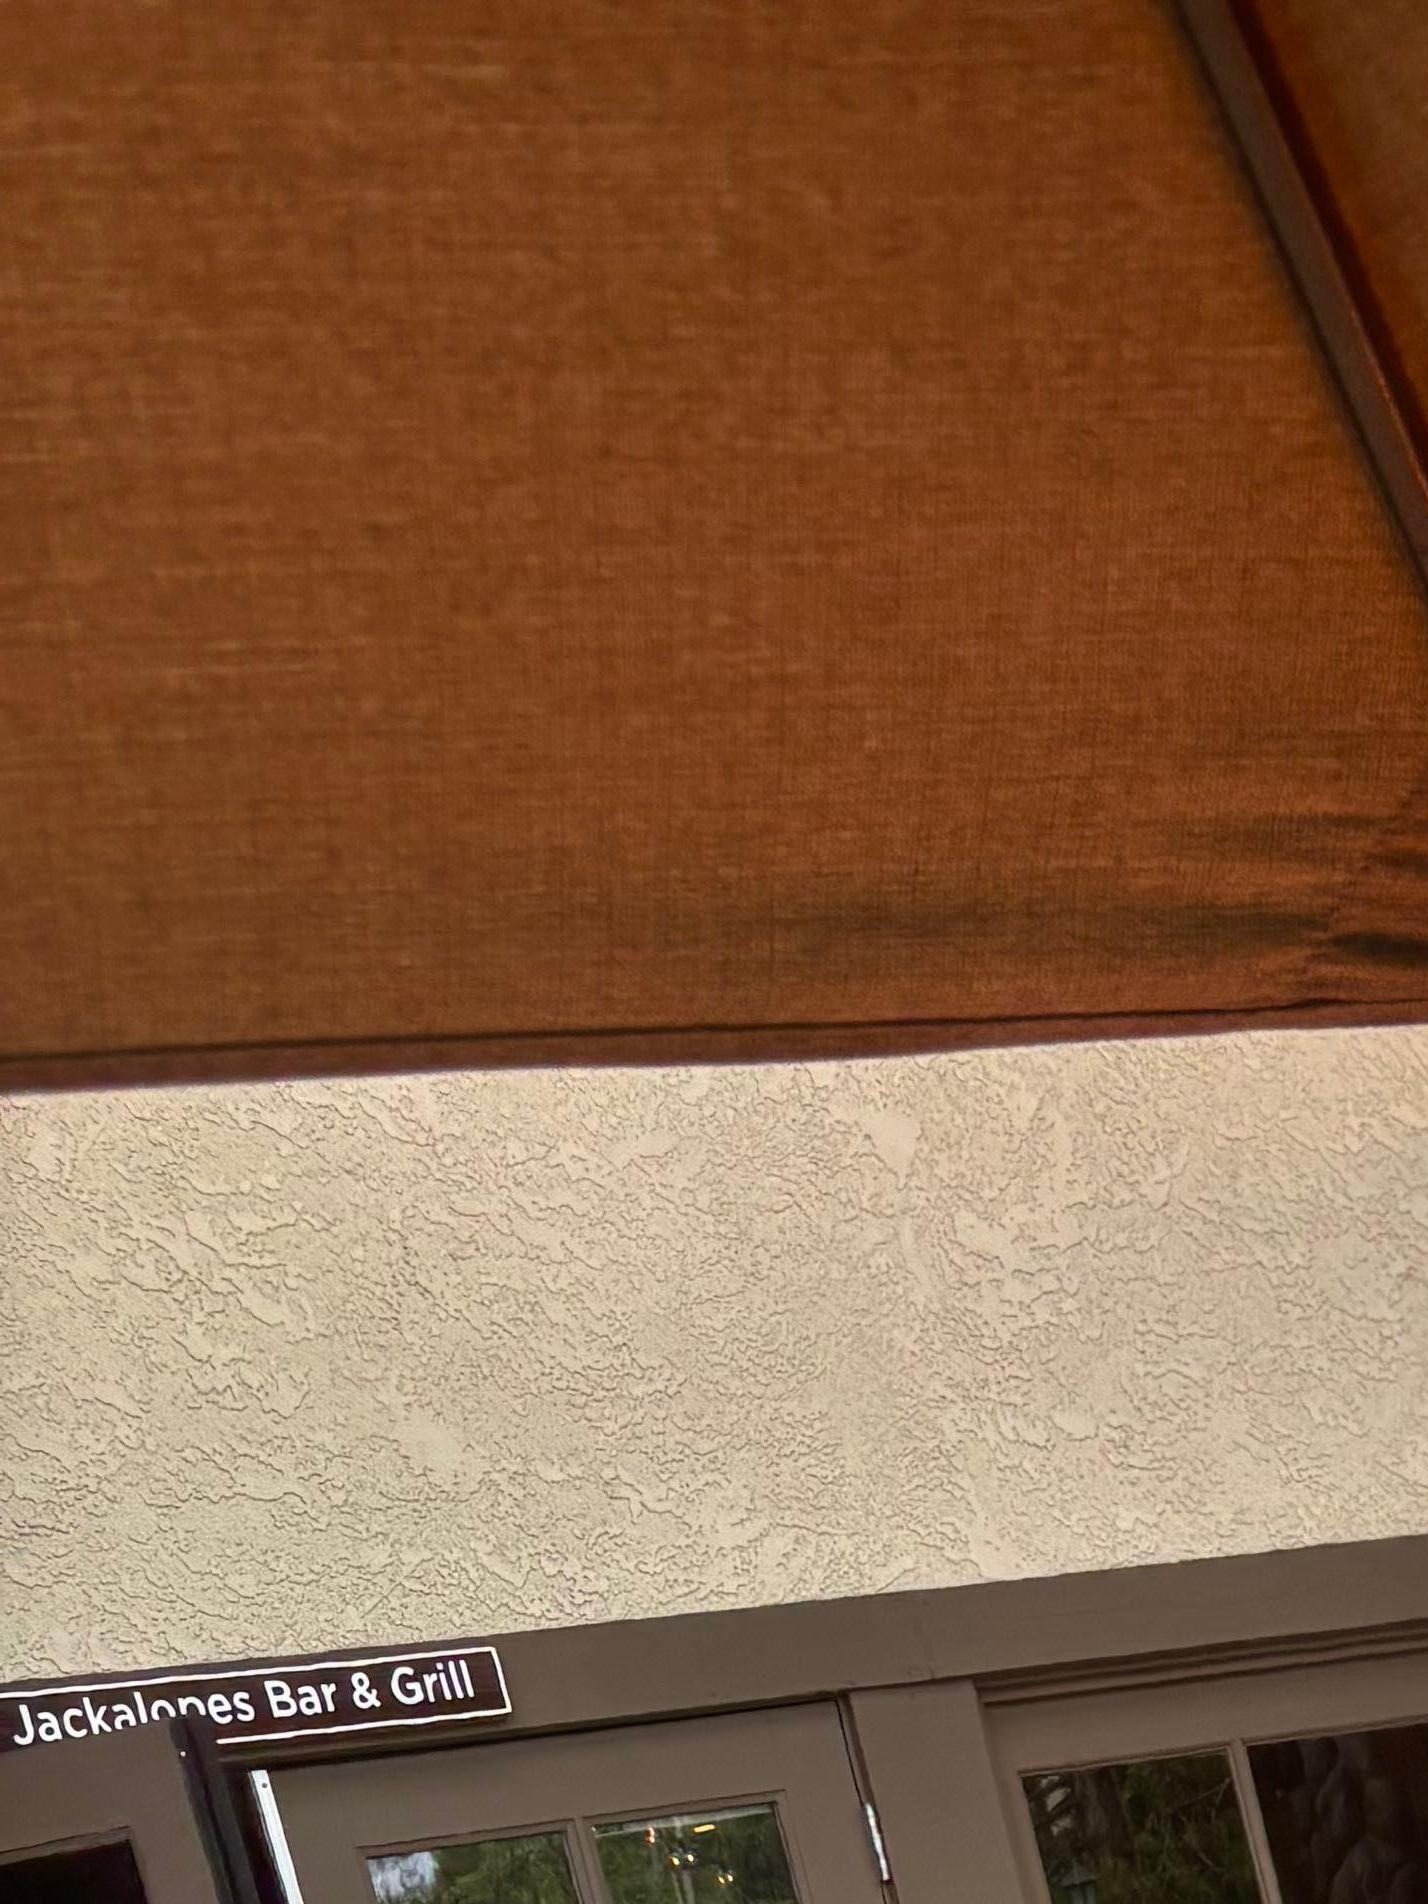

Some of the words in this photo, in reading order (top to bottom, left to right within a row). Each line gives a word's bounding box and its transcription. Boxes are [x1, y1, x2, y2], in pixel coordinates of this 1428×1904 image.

[263, 1679, 337, 1719] Bar
[350, 1671, 382, 1710] &
[390, 1658, 475, 1706] Grill
